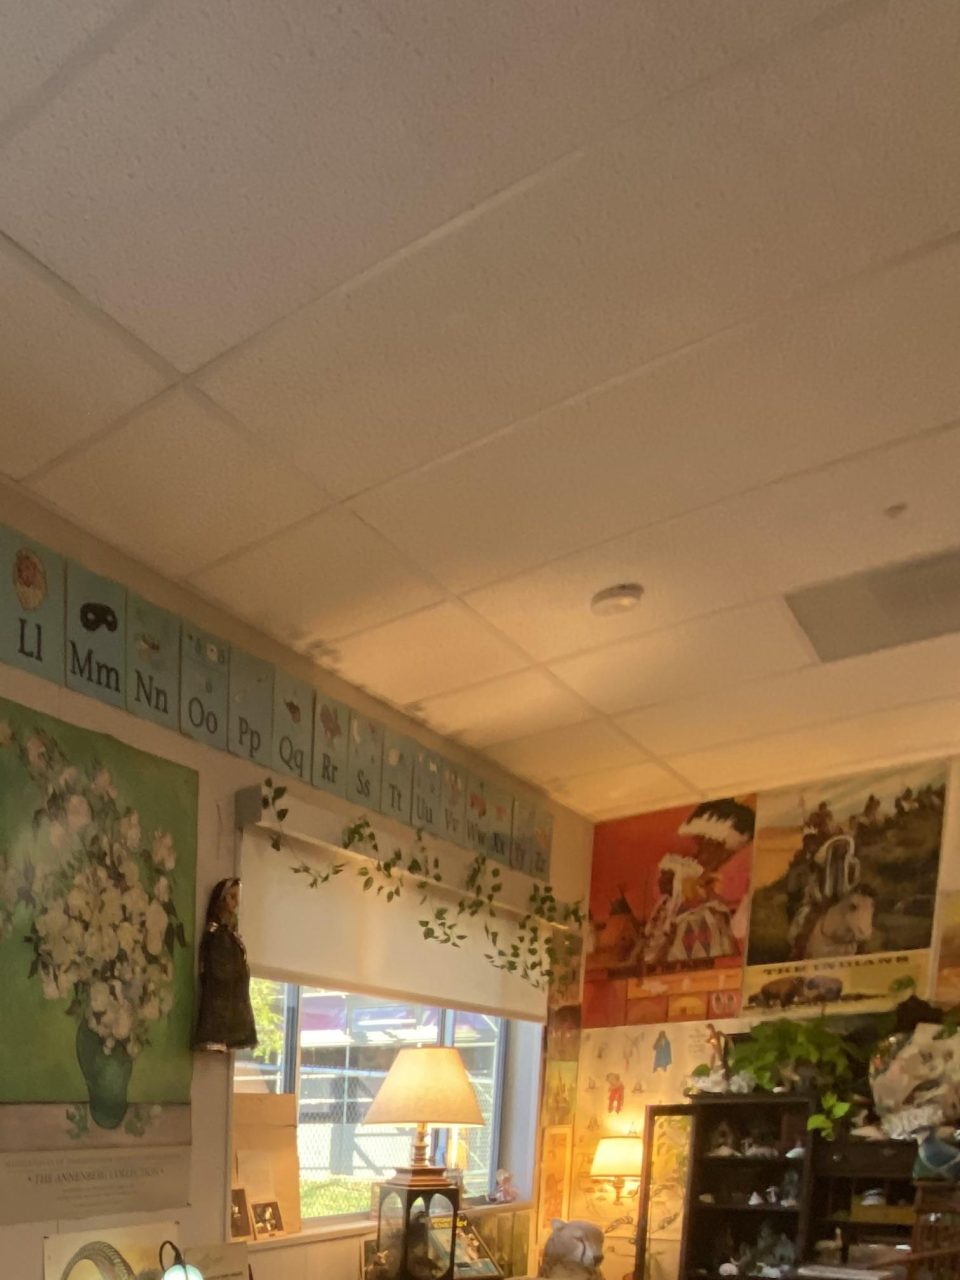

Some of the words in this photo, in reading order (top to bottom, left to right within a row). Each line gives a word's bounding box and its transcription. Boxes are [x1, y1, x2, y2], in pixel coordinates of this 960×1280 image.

[17, 618, 43, 663] Ll
[69, 640, 121, 693] Mm
[135, 669, 169, 714] Nn
[188, 697, 218, 734] Oo
[238, 716, 261, 758] Pp
[279, 735, 305, 778] Qq
[321, 752, 338, 784] Rr
[356, 769, 371, 798] Ss
[389, 783, 402, 812] Tt
[417, 796, 433, 824] Uu
[444, 808, 460, 832] Vv
[467, 819, 487, 846] Ww
